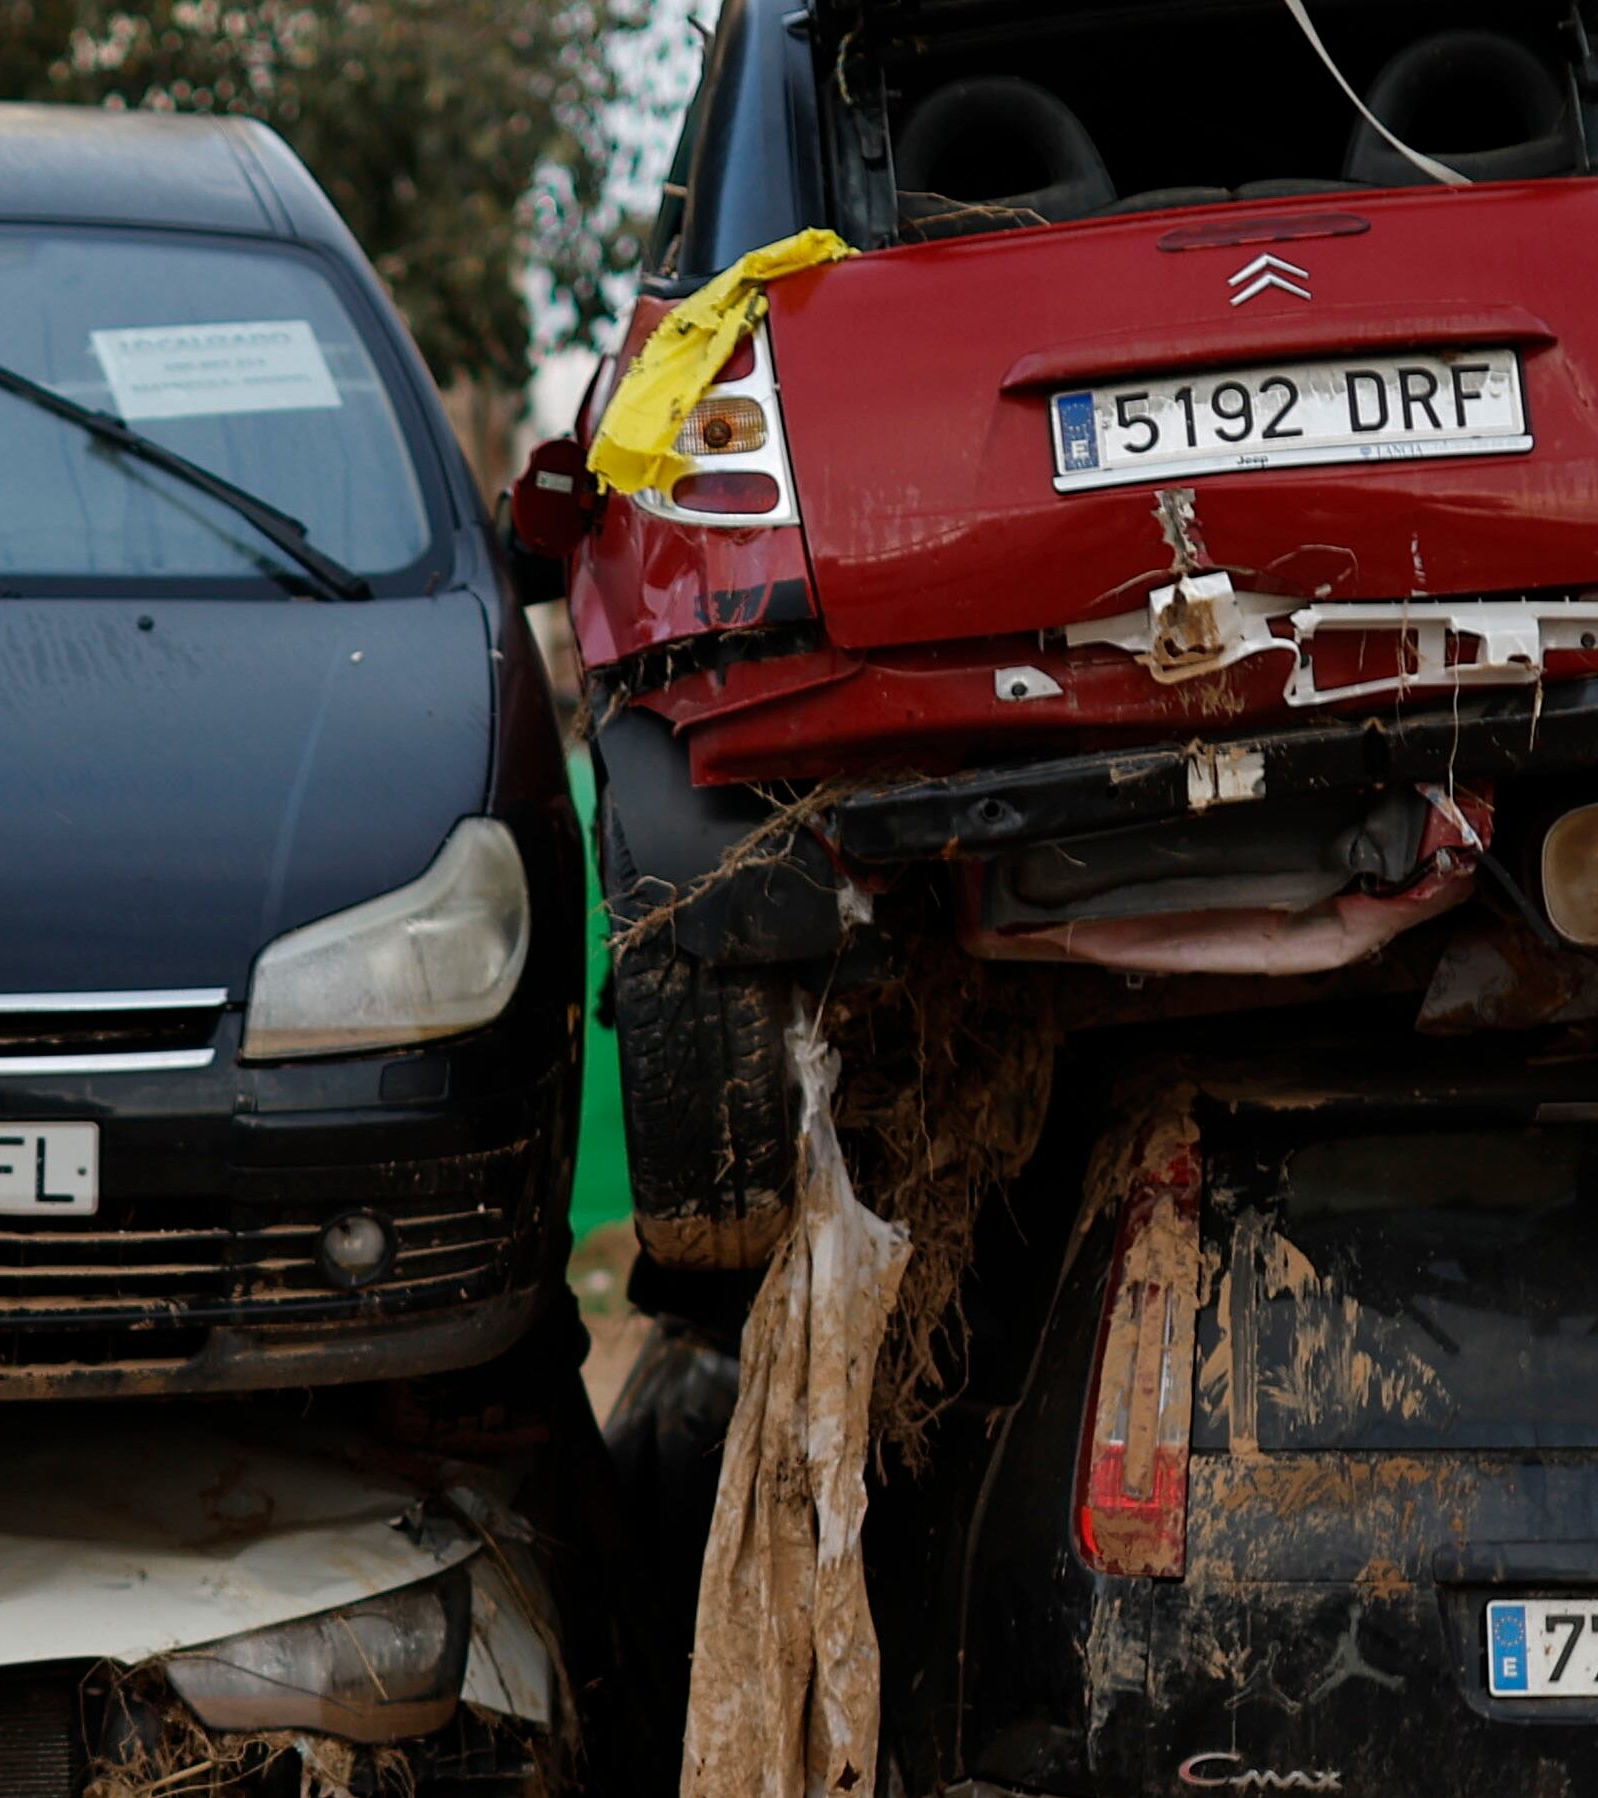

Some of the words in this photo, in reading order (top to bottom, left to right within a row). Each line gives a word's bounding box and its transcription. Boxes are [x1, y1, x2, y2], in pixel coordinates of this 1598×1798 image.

[1115, 376, 1303, 453] 5192
[1346, 364, 1491, 433] DRF
[1503, 1656, 1518, 1678] E
[1545, 1613, 1598, 1683] 7
